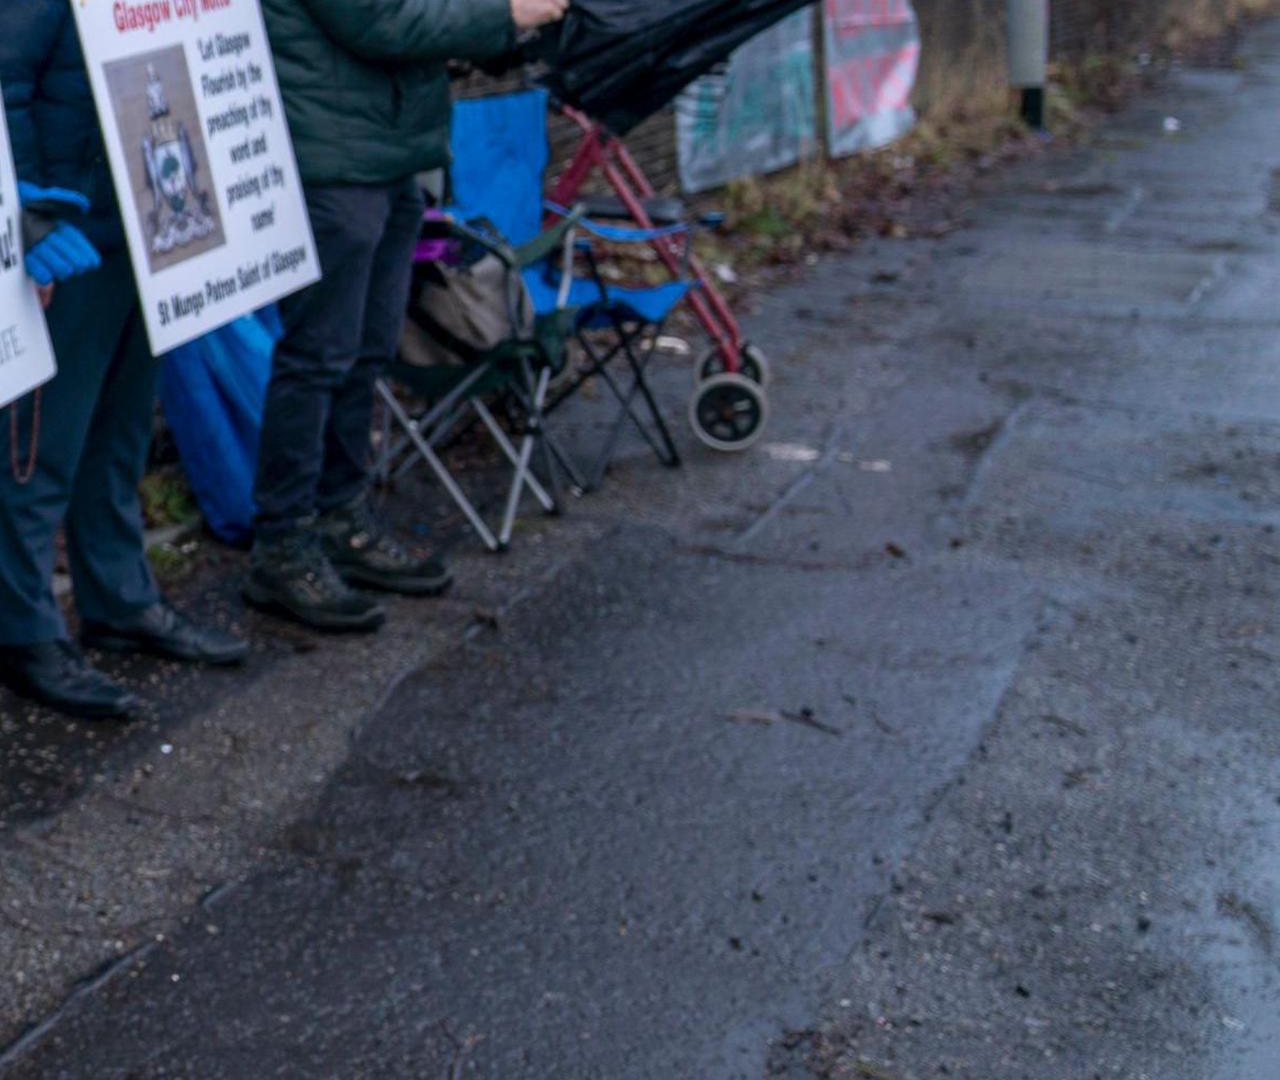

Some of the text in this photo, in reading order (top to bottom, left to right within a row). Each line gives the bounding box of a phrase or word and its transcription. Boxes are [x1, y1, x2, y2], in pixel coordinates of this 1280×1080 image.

[113, 0, 171, 34] Glasgow
[171, 288, 205, 319] Mungo
[205, 277, 237, 305] Patron
